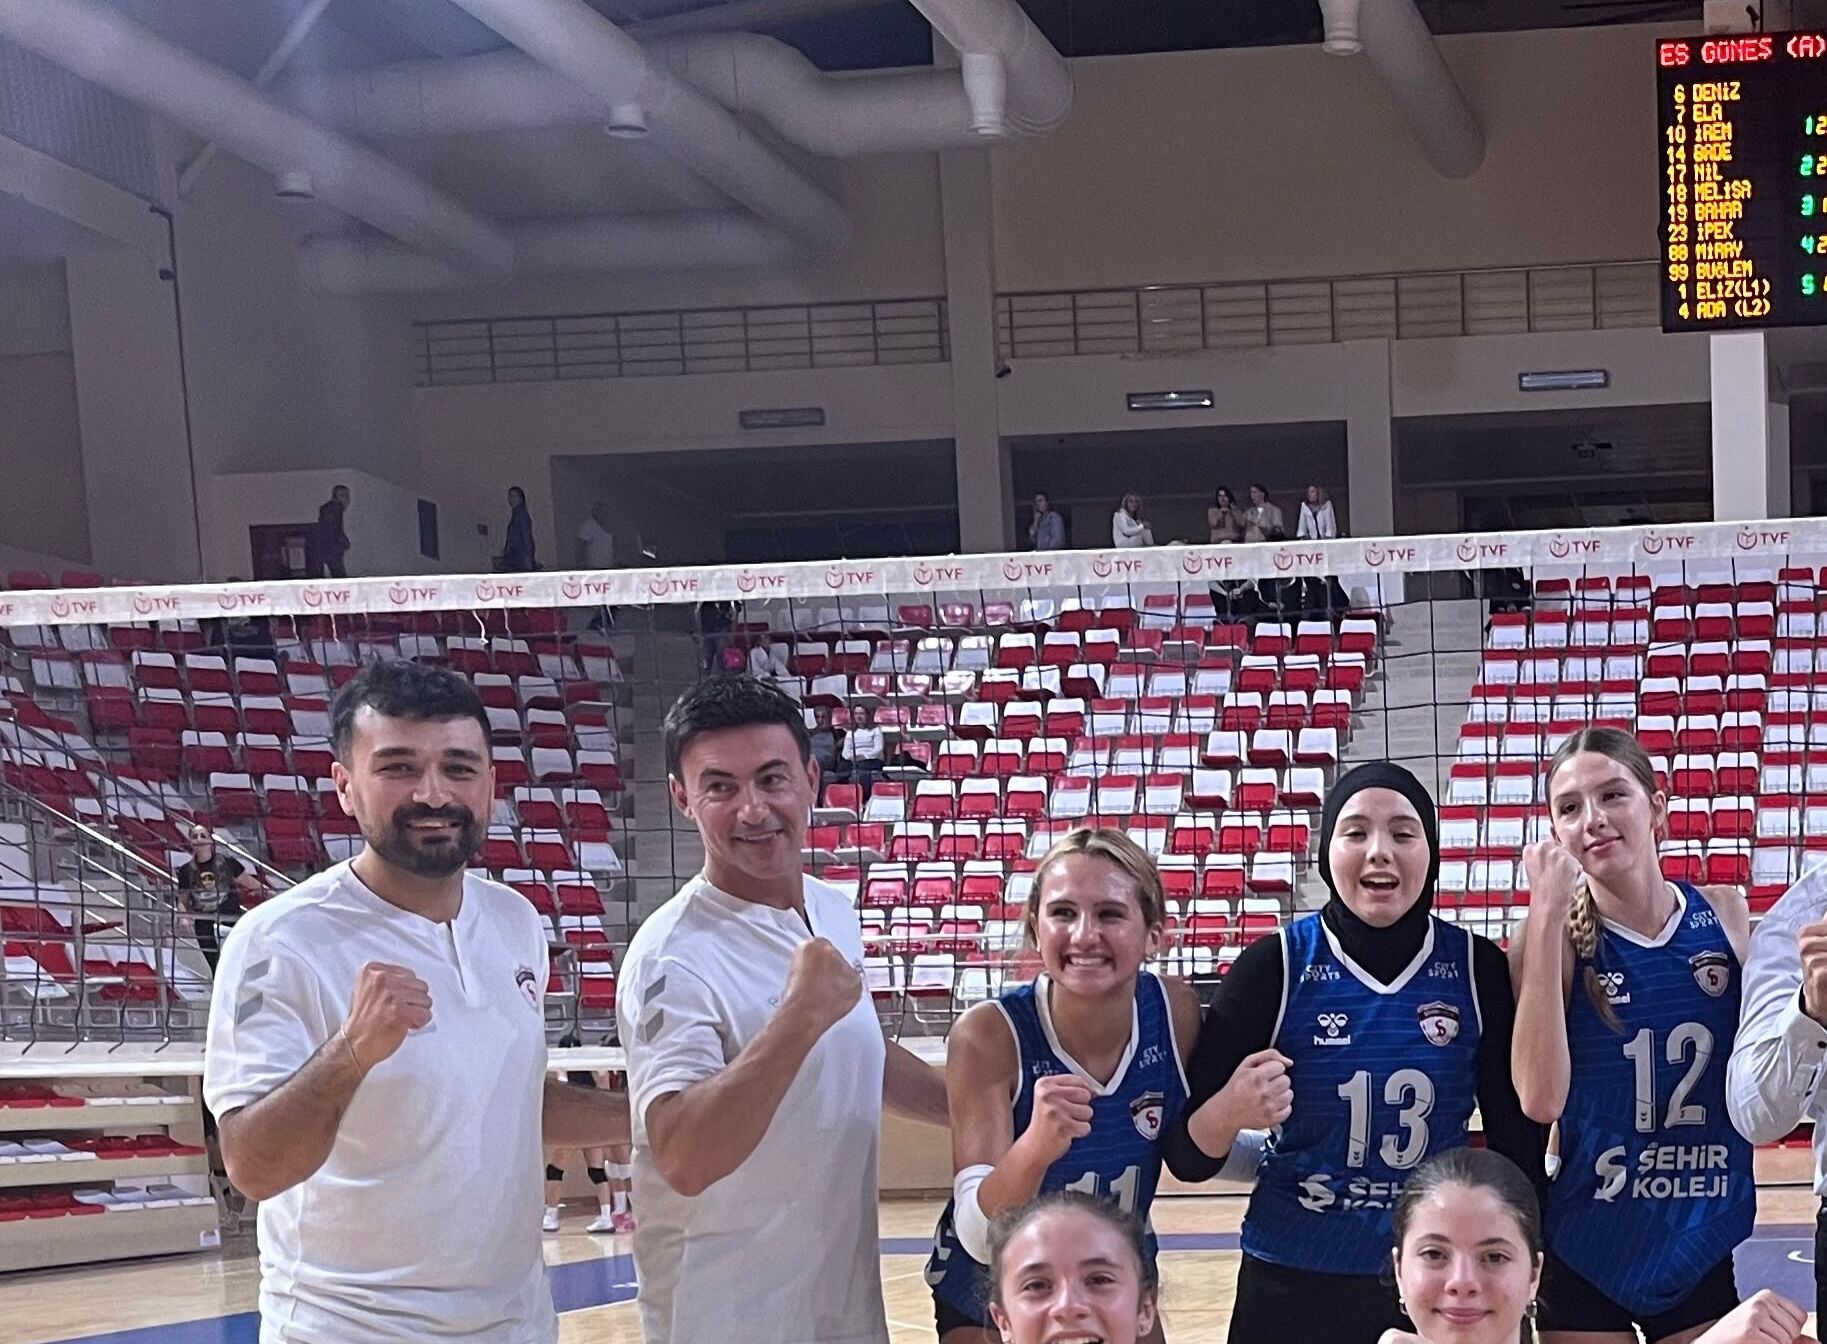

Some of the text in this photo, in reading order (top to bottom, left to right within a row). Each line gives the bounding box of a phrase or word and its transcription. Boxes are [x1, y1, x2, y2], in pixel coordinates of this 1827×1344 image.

[1787, 35, 1826, 58] (A)
[1674, 84, 1686, 103] 6
[1675, 103, 1722, 123] 7 ELA
[1666, 125, 1686, 143] 10
[1805, 115, 1813, 135] 1
[1667, 145, 1685, 163] 14
[1667, 163, 1686, 182] 17
[1800, 155, 1813, 175] 2
[1667, 184, 1687, 202] 18
[1668, 204, 1688, 222] 19
[1801, 194, 1813, 215] 3
[1668, 224, 1688, 242] 23
[1668, 244, 1688, 261] 88
[1801, 235, 1814, 254] 4
[1669, 264, 1688, 281] 99
[1678, 284, 1686, 299] 1
[1801, 274, 1814, 295] 5
[1679, 298, 1771, 319] 4 ADA (L2)
[1760, 532, 1790, 545] TVF
[1296, 552, 1323, 566] TVF
[1479, 544, 1508, 557] TVF
[935, 568, 963, 581] TVF
[1115, 560, 1142, 573] TVF
[584, 583, 609, 595] TVF
[758, 575, 787, 588] TVF
[239, 593, 264, 606] TVF
[410, 588, 435, 601] TVF
[71, 601, 96, 613] TVF
[1623, 1022, 1714, 1133] 12
[1337, 1069, 1436, 1170] 13
[1632, 1175, 1729, 1199] KOLEJİ
